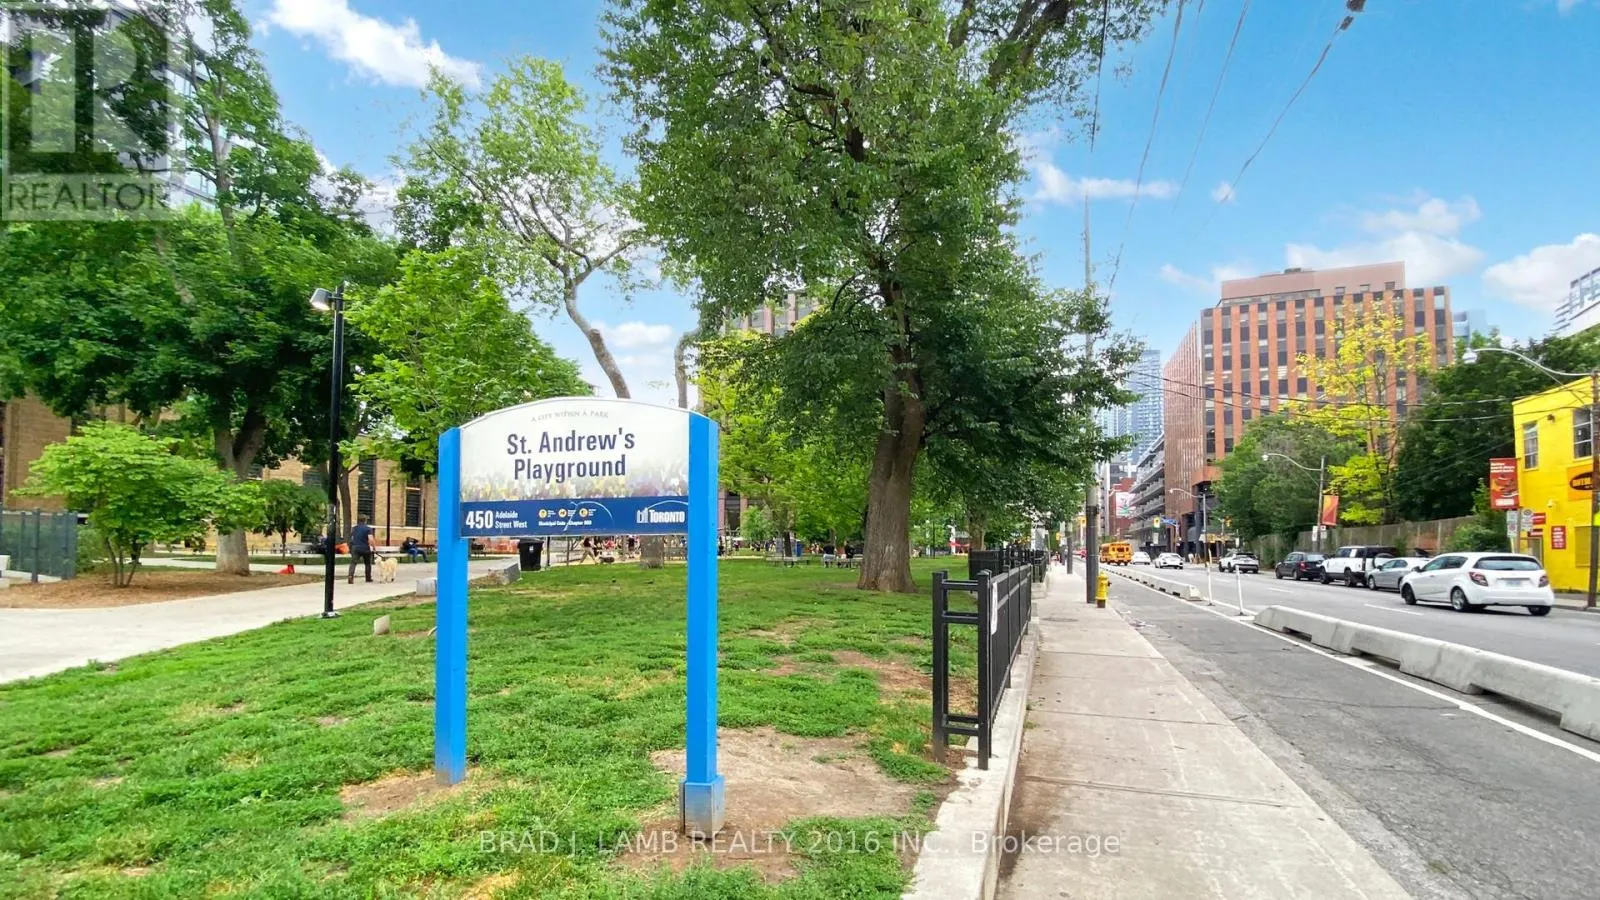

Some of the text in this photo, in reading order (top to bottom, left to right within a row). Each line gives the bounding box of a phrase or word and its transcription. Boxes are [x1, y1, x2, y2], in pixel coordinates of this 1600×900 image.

[507, 427, 635, 455] St. Andrew's
[514, 454, 626, 483] Playground
[465, 510, 494, 529] 450
[495, 510, 519, 519] Adelaide
[648, 509, 686, 524] TORONTO
[495, 520, 528, 529] Street West
